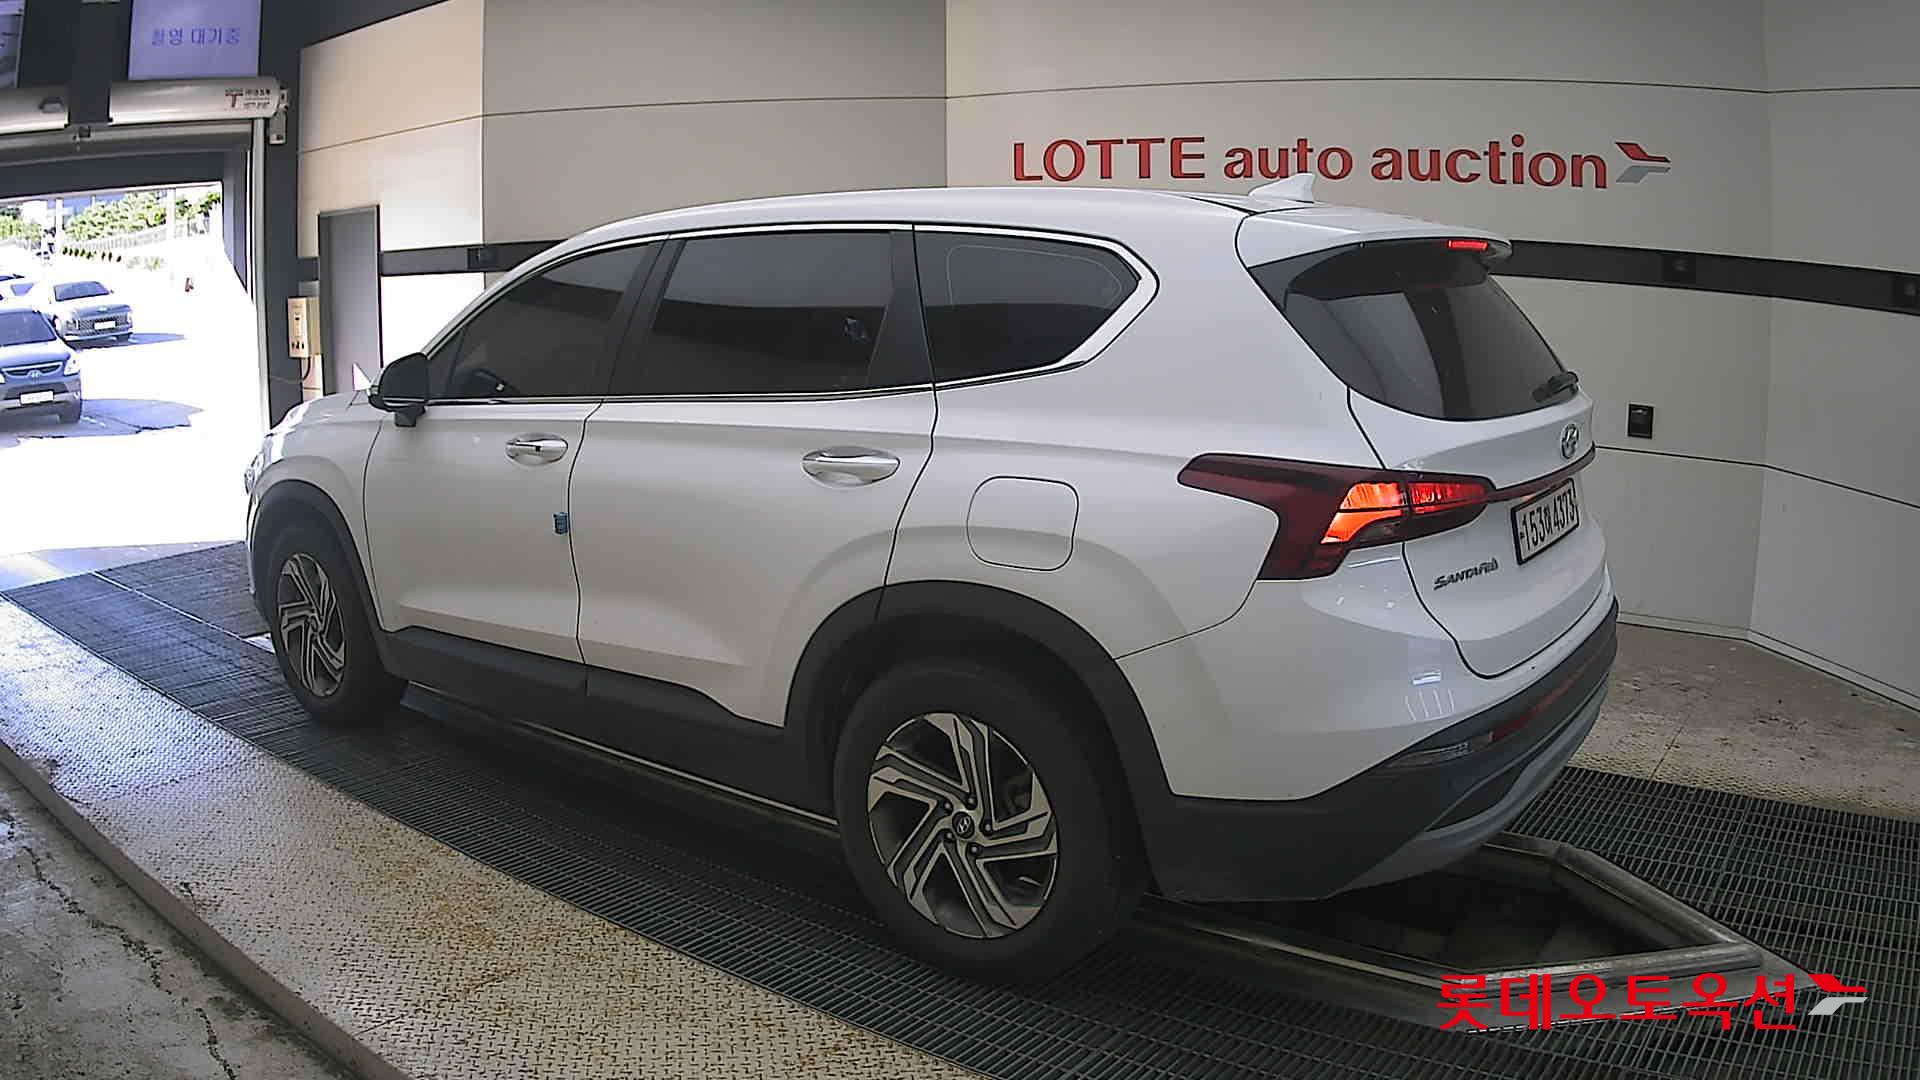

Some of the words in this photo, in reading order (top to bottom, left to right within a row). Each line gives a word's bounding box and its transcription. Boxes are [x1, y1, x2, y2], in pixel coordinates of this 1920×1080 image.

[1014, 138, 1206, 181] LOTTE
[1225, 136, 1355, 180] auto
[1370, 134, 1607, 187] auction
